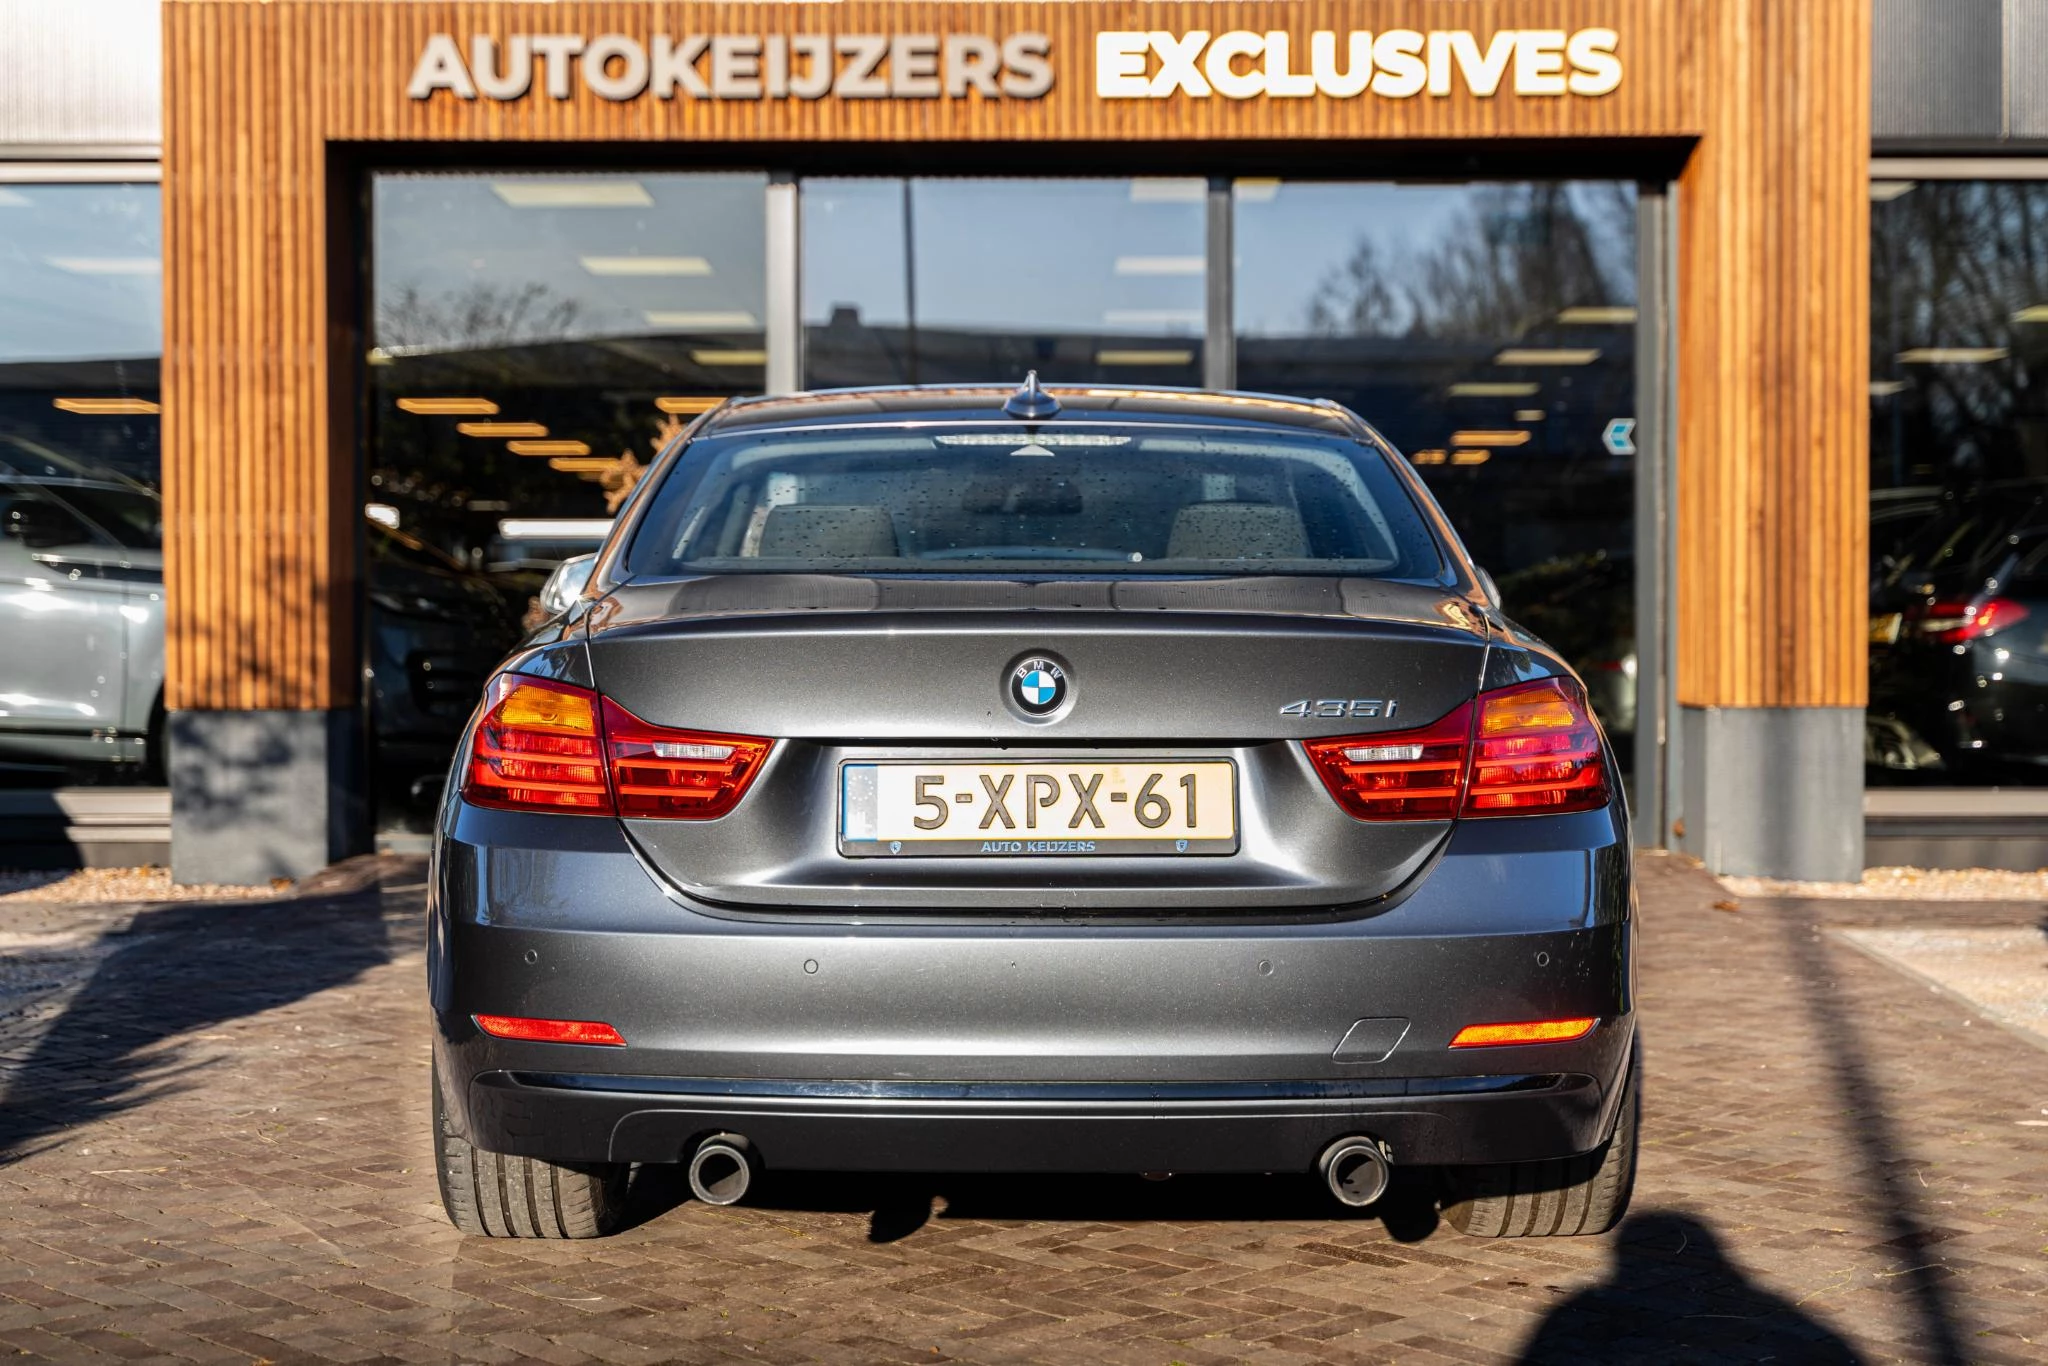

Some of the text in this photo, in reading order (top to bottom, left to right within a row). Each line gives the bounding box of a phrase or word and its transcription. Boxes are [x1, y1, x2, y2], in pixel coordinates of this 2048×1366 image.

[407, 28, 1623, 100] AUTOKEIJZERS EXCLUSIVES
[1016, 661, 1062, 680] BMW
[1280, 699, 1397, 718] 435i
[913, 773, 1197, 830] 5-XPX-61
[980, 840, 1096, 852] AUTO KEIJZERS
